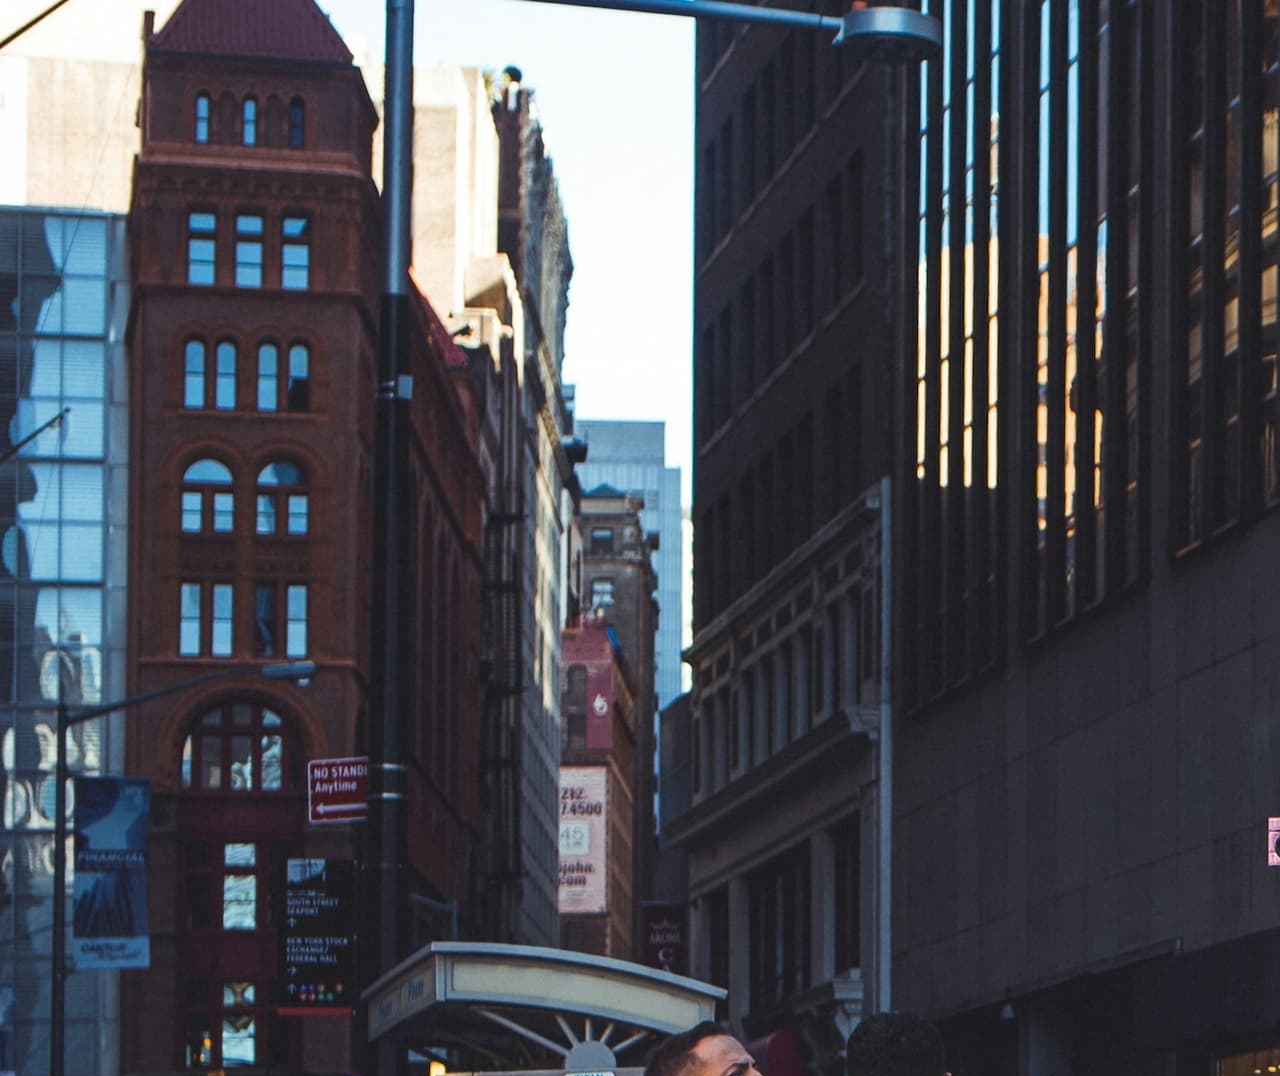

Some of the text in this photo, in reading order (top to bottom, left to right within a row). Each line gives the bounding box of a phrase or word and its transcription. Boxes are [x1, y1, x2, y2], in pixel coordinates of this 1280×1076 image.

[314, 764, 367, 779] NO STANDI
[315, 779, 357, 795] Anytime
